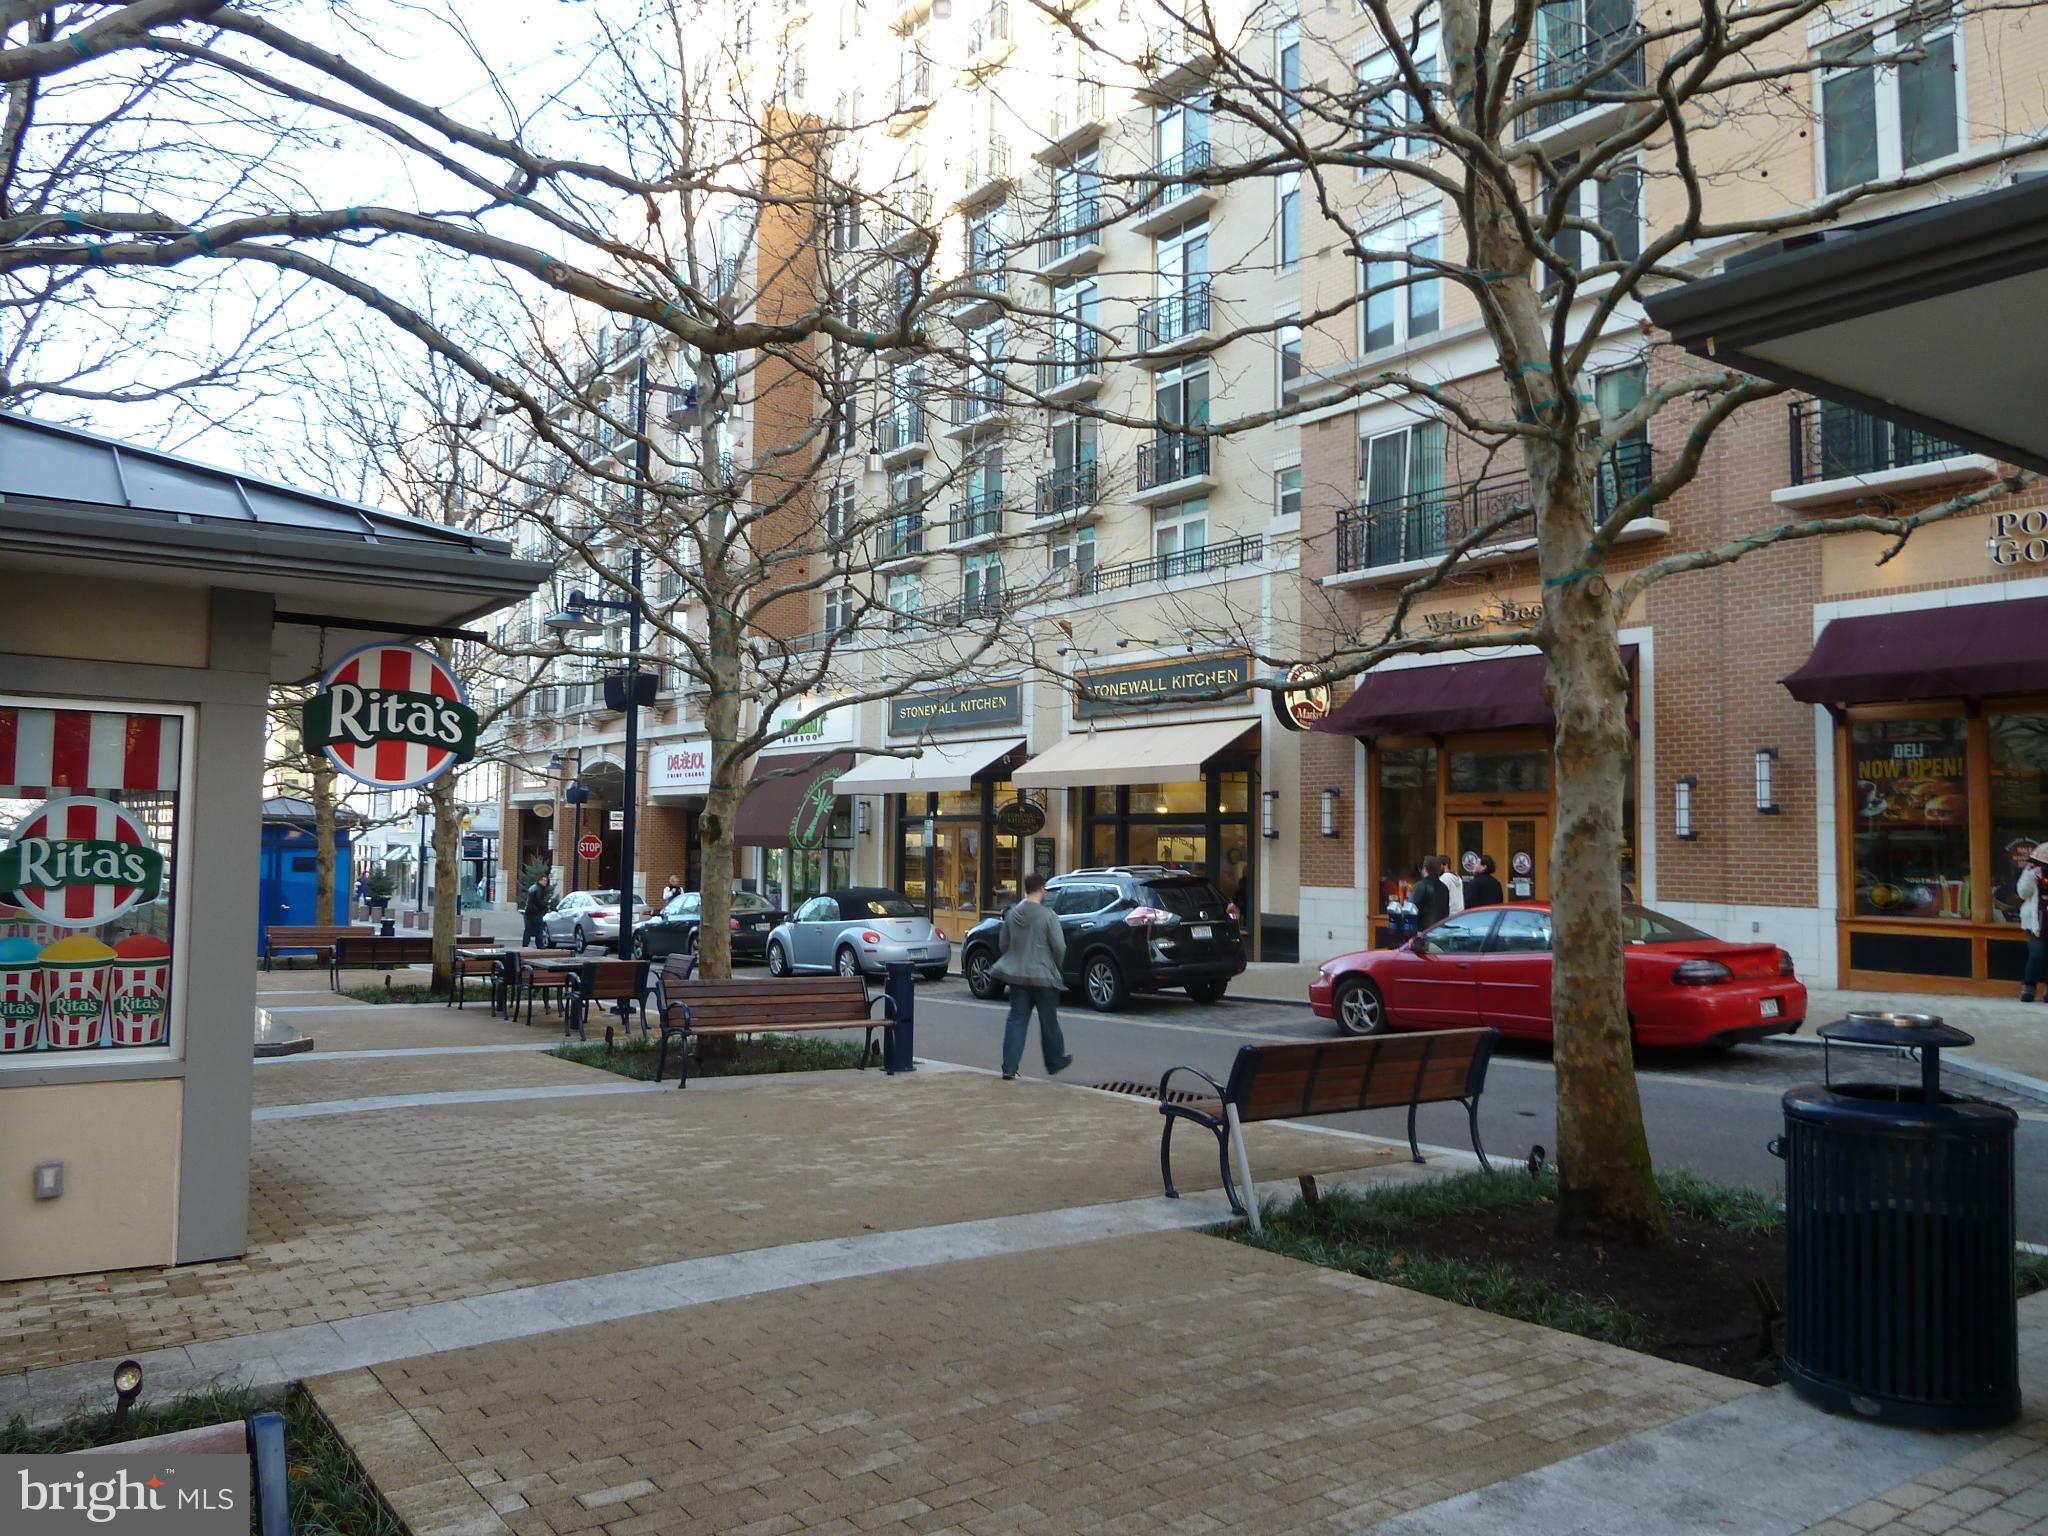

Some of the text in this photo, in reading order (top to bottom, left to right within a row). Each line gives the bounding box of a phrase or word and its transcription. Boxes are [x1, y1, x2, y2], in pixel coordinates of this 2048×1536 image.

[1423, 610, 1482, 633] Wine
[1086, 668, 1239, 697] TONEWALL KITCHEN
[960, 696, 1007, 713] KITCHEN
[329, 684, 463, 743] Rita's
[1894, 743, 1924, 758] DELI
[1859, 757, 1964, 779] NOW OPEN!
[580, 842, 600, 852] STOP
[19, 838, 146, 887] Rita's
[0, 1002, 35, 1015] ita's
[56, 998, 98, 1015] Rita's
[120, 995, 160, 1012] Rita's
